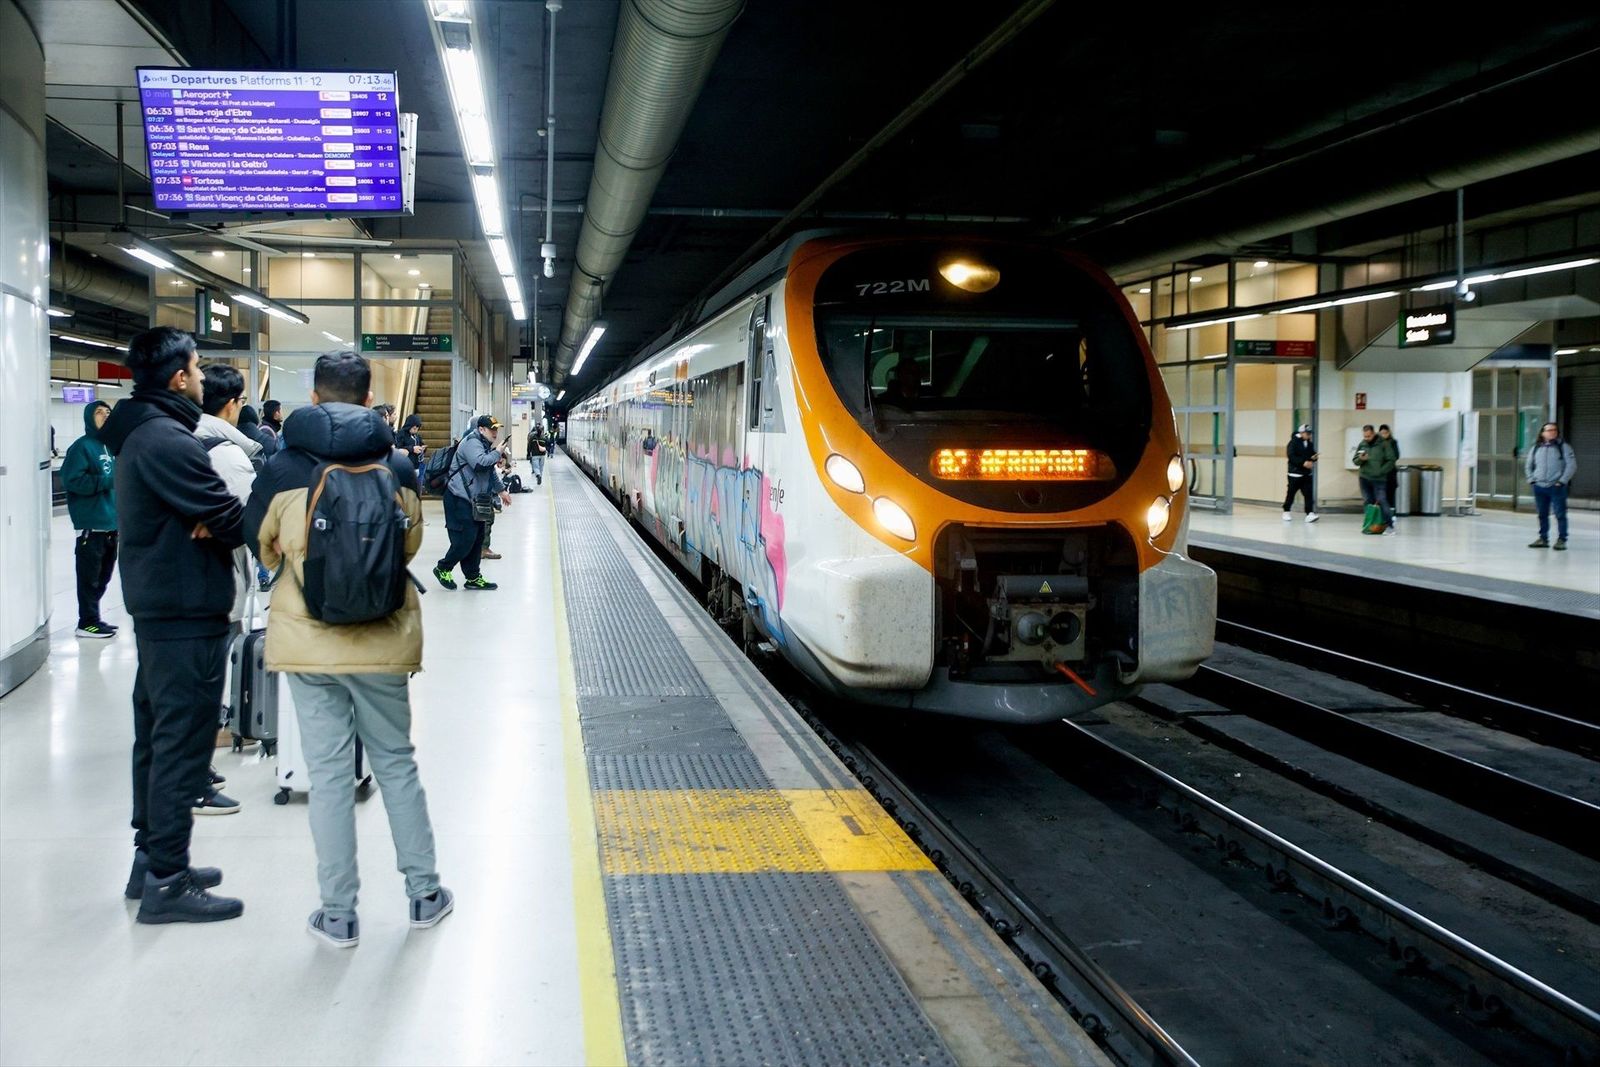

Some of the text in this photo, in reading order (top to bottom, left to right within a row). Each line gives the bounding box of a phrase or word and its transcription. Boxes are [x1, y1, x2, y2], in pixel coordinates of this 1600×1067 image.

[171, 74, 322, 86] Departures Platforms 11 12
[183, 91, 221, 100] Aeroport
[147, 107, 173, 115] 06:33
[185, 108, 223, 118] Riba-roja
[225, 108, 252, 117] d'Ebre
[208, 126, 236, 135] Vicenç
[215, 194, 243, 202] Vicenç
[856, 279, 930, 296] 722M
